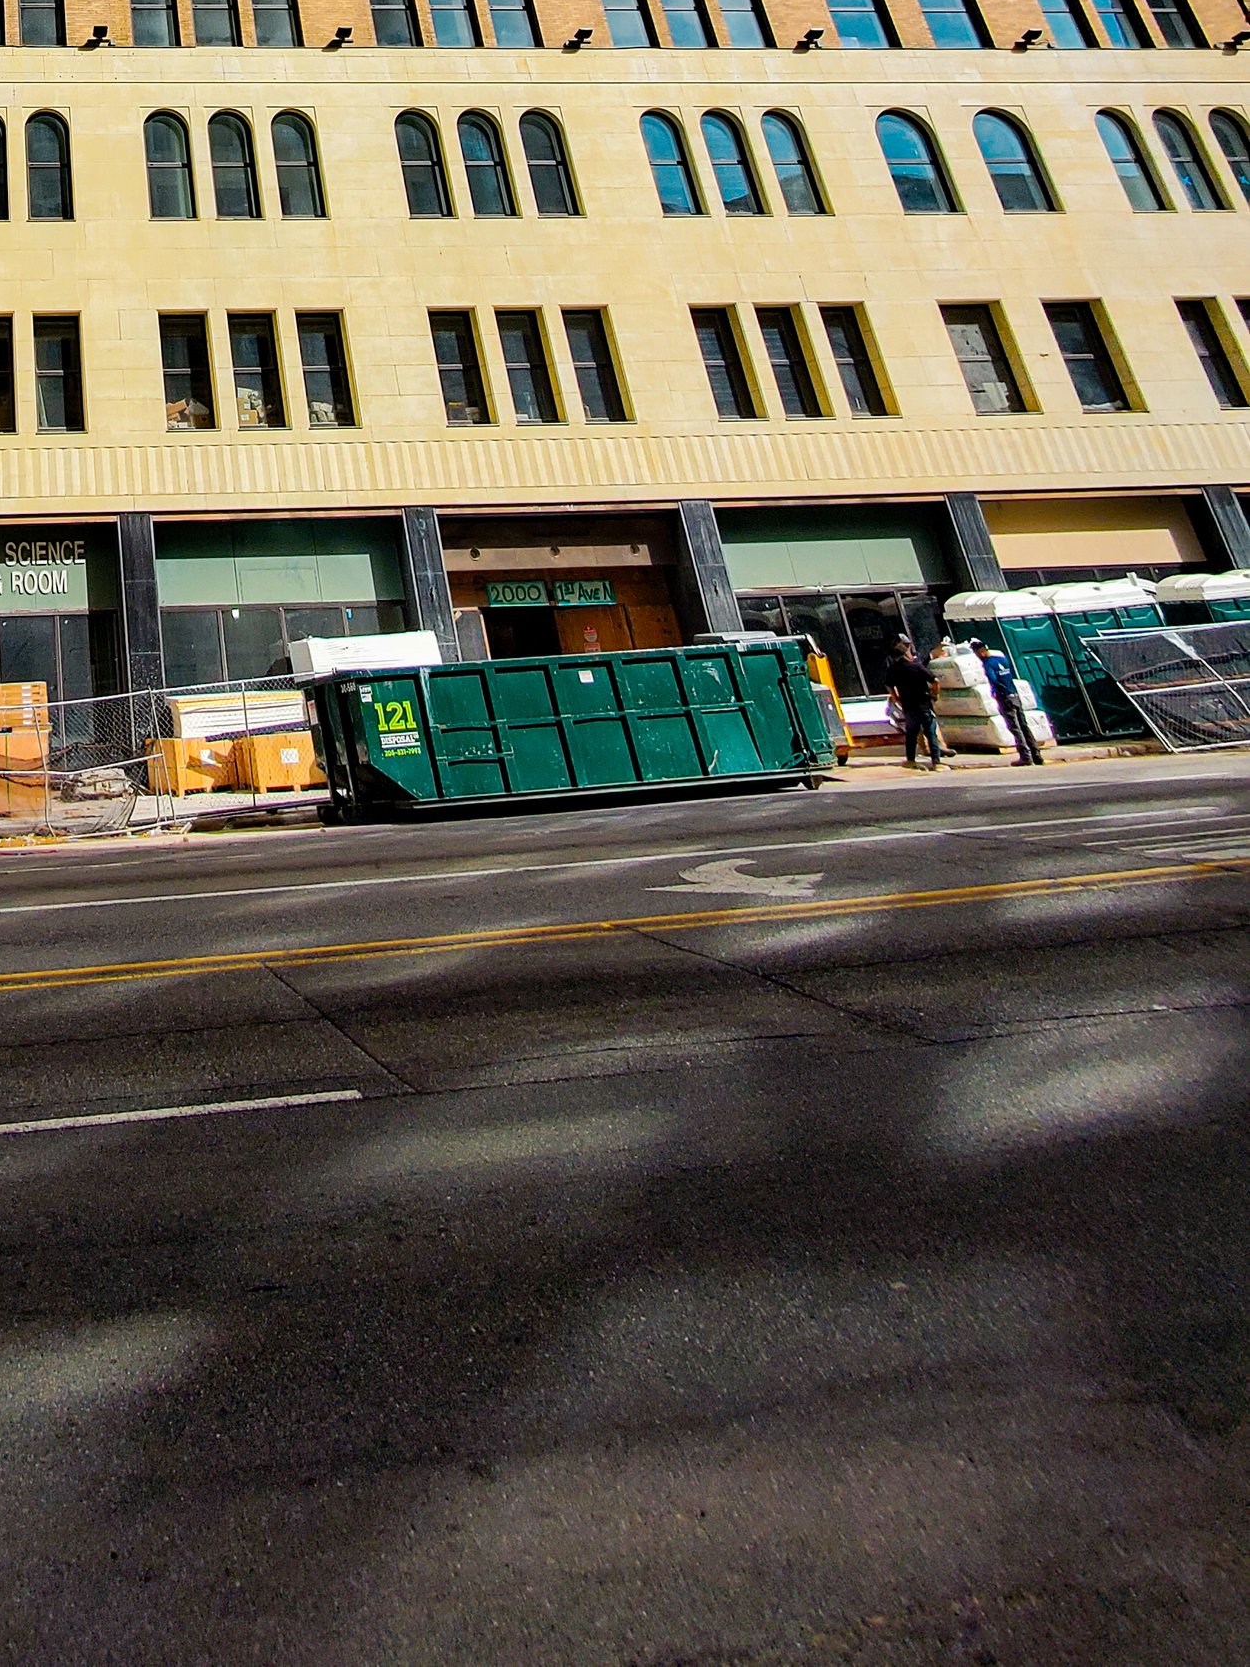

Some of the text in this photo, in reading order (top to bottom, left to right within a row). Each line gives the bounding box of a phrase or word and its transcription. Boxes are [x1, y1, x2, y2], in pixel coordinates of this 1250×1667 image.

[5, 541, 86, 566] SCIENCE
[11, 570, 69, 594] ROOM
[602, 581, 613, 601] N
[490, 584, 542, 603] 2000
[374, 700, 418, 731] 121
[381, 734, 416, 745] DISPOSAL
